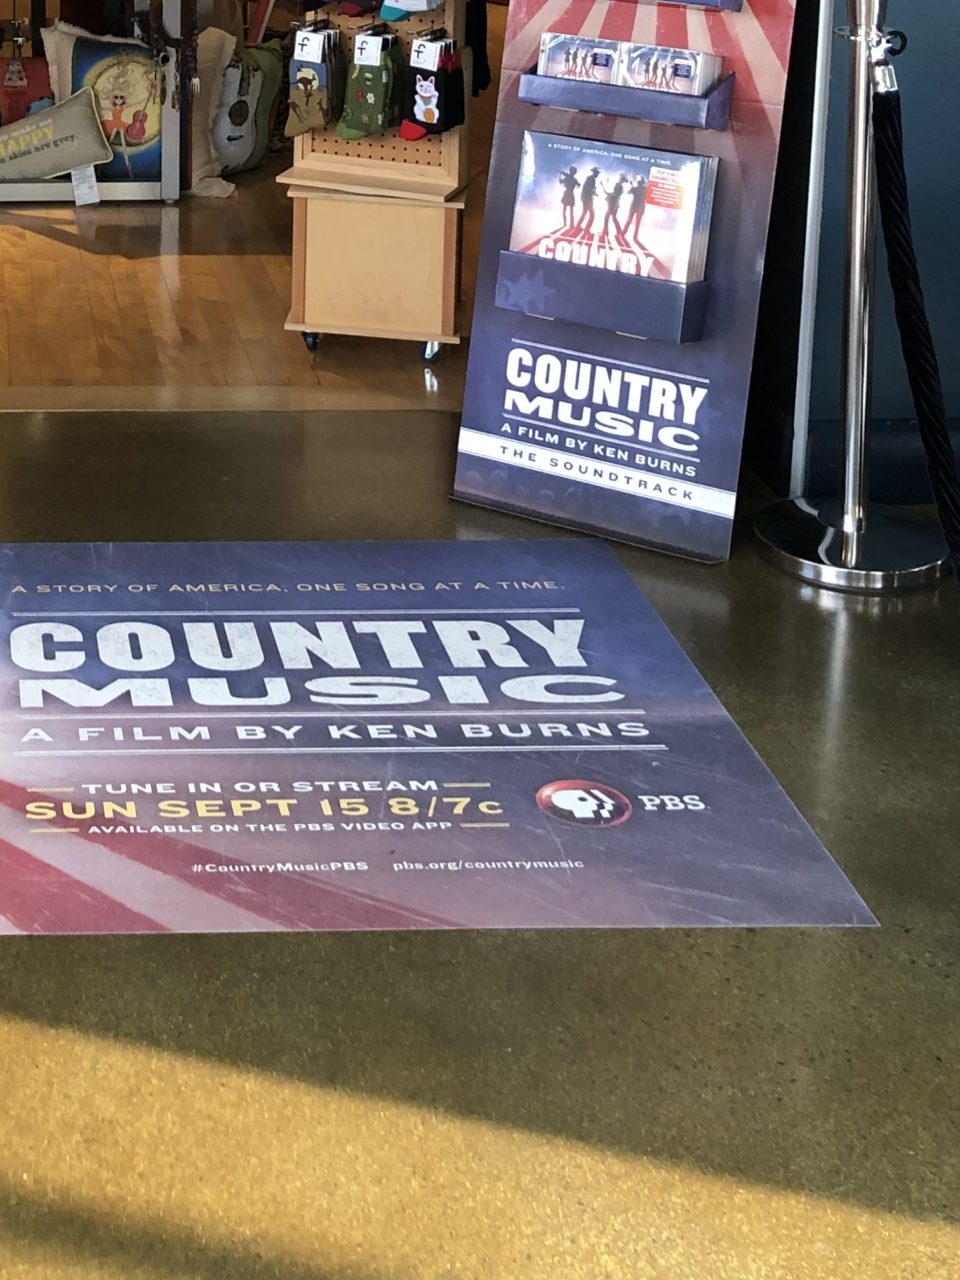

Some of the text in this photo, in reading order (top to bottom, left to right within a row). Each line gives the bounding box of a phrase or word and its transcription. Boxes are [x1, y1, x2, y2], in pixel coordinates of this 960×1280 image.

[8, 148, 33, 163] skies
[34, 141, 52, 153] are
[554, 143, 571, 151] STORY
[538, 238, 654, 278] COUNTRY
[506, 348, 709, 425] COUNTRY
[504, 389, 700, 452] MUSIC
[501, 423, 696, 477] A FILM BY KEN BURNS
[501, 446, 693, 500] THE SOUNDTRACK
[12, 581, 565, 593] A STORY OF AMERICA. ONE SONG AT A TIME.
[10, 619, 588, 672] COUNTRY
[19, 674, 626, 707] MUSIC
[20, 722, 650, 742] A FILM BY KEN BURNS
[82, 780, 438, 795] TUNE IN OR STREAM
[25, 796, 504, 819] SUN SEPT 15 8/7c
[638, 794, 707, 811] PBS
[88, 822, 452, 833] AVAILABLE ON THE PBS VIDEO APP
[191, 859, 584, 873] #CountryMusicPBS pbs.org/countrymusic
